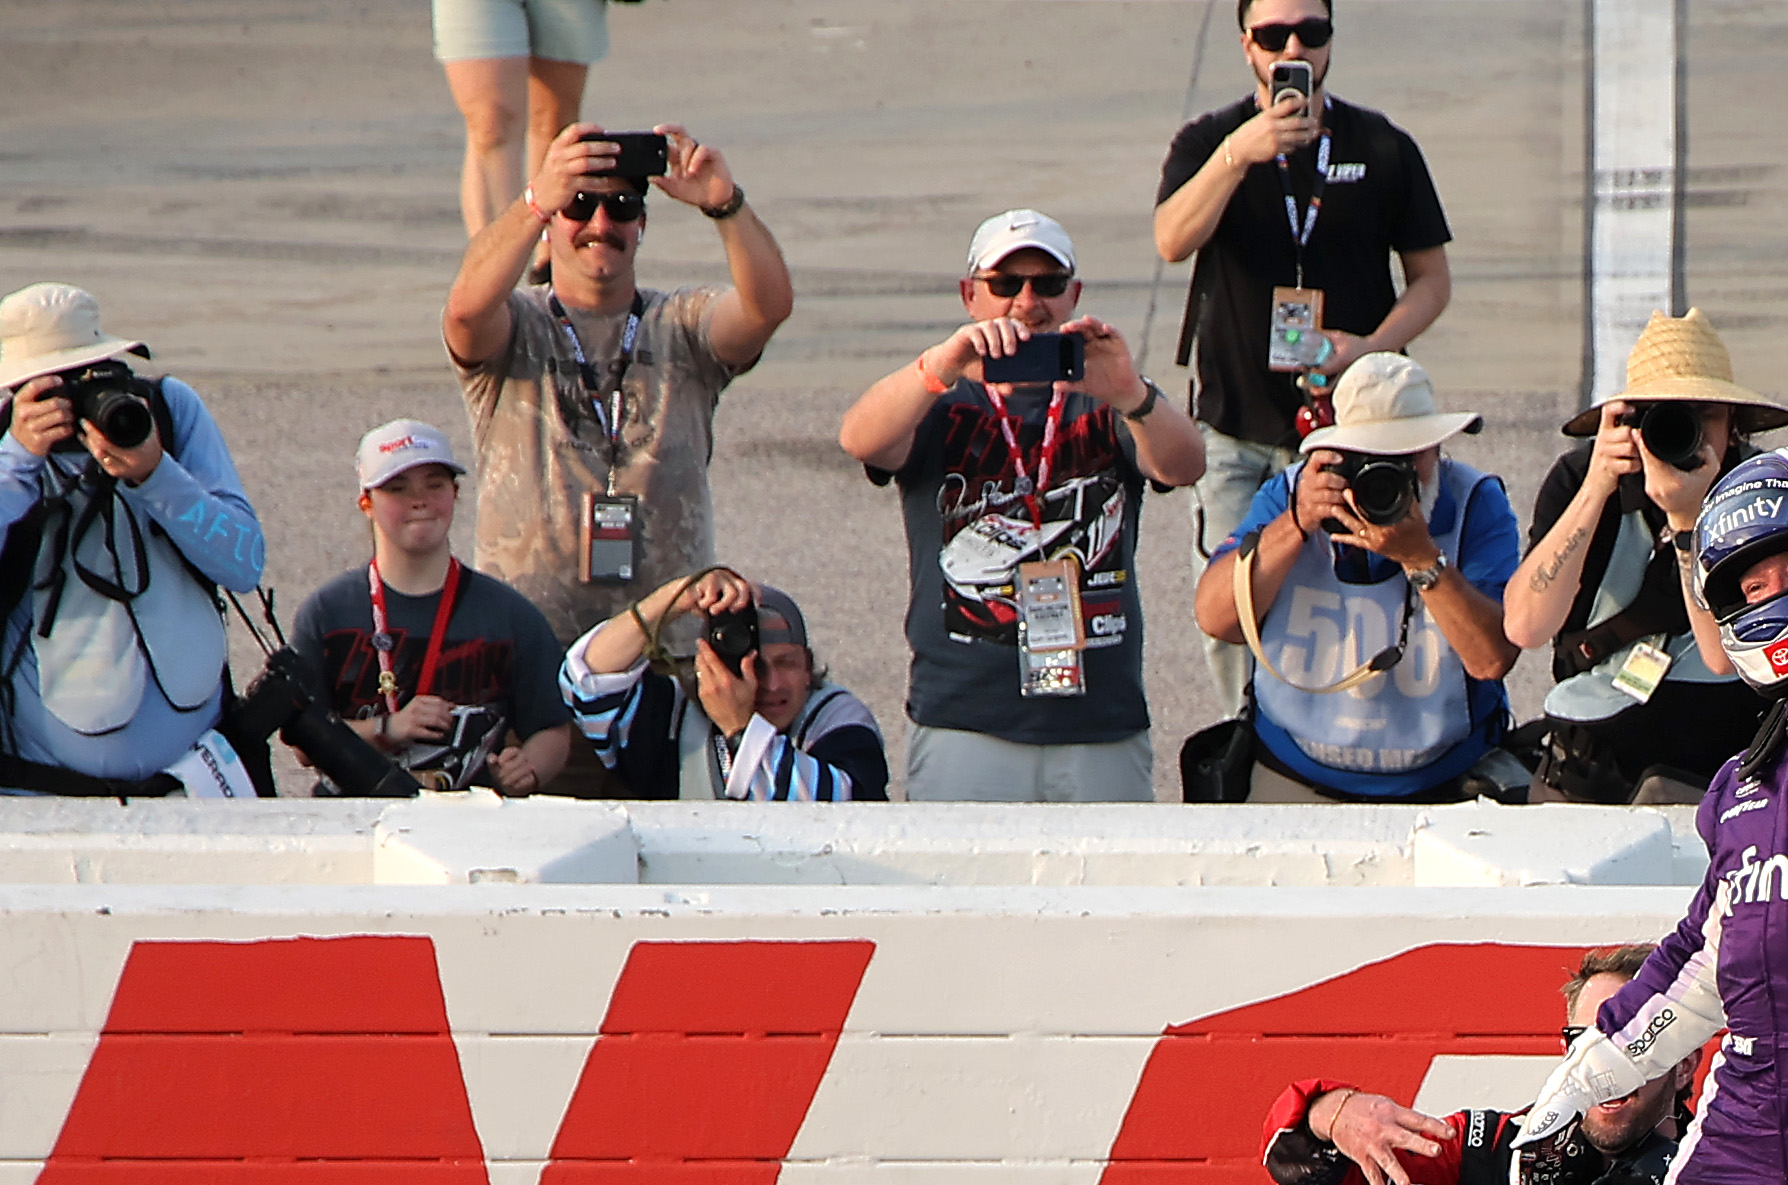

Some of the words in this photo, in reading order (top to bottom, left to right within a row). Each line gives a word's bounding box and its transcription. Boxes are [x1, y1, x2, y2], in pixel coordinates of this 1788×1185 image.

[1714, 480, 1764, 504] Imagine
[1706, 496, 1784, 543] xfinity
[1626, 1007, 1677, 1058] sparco
